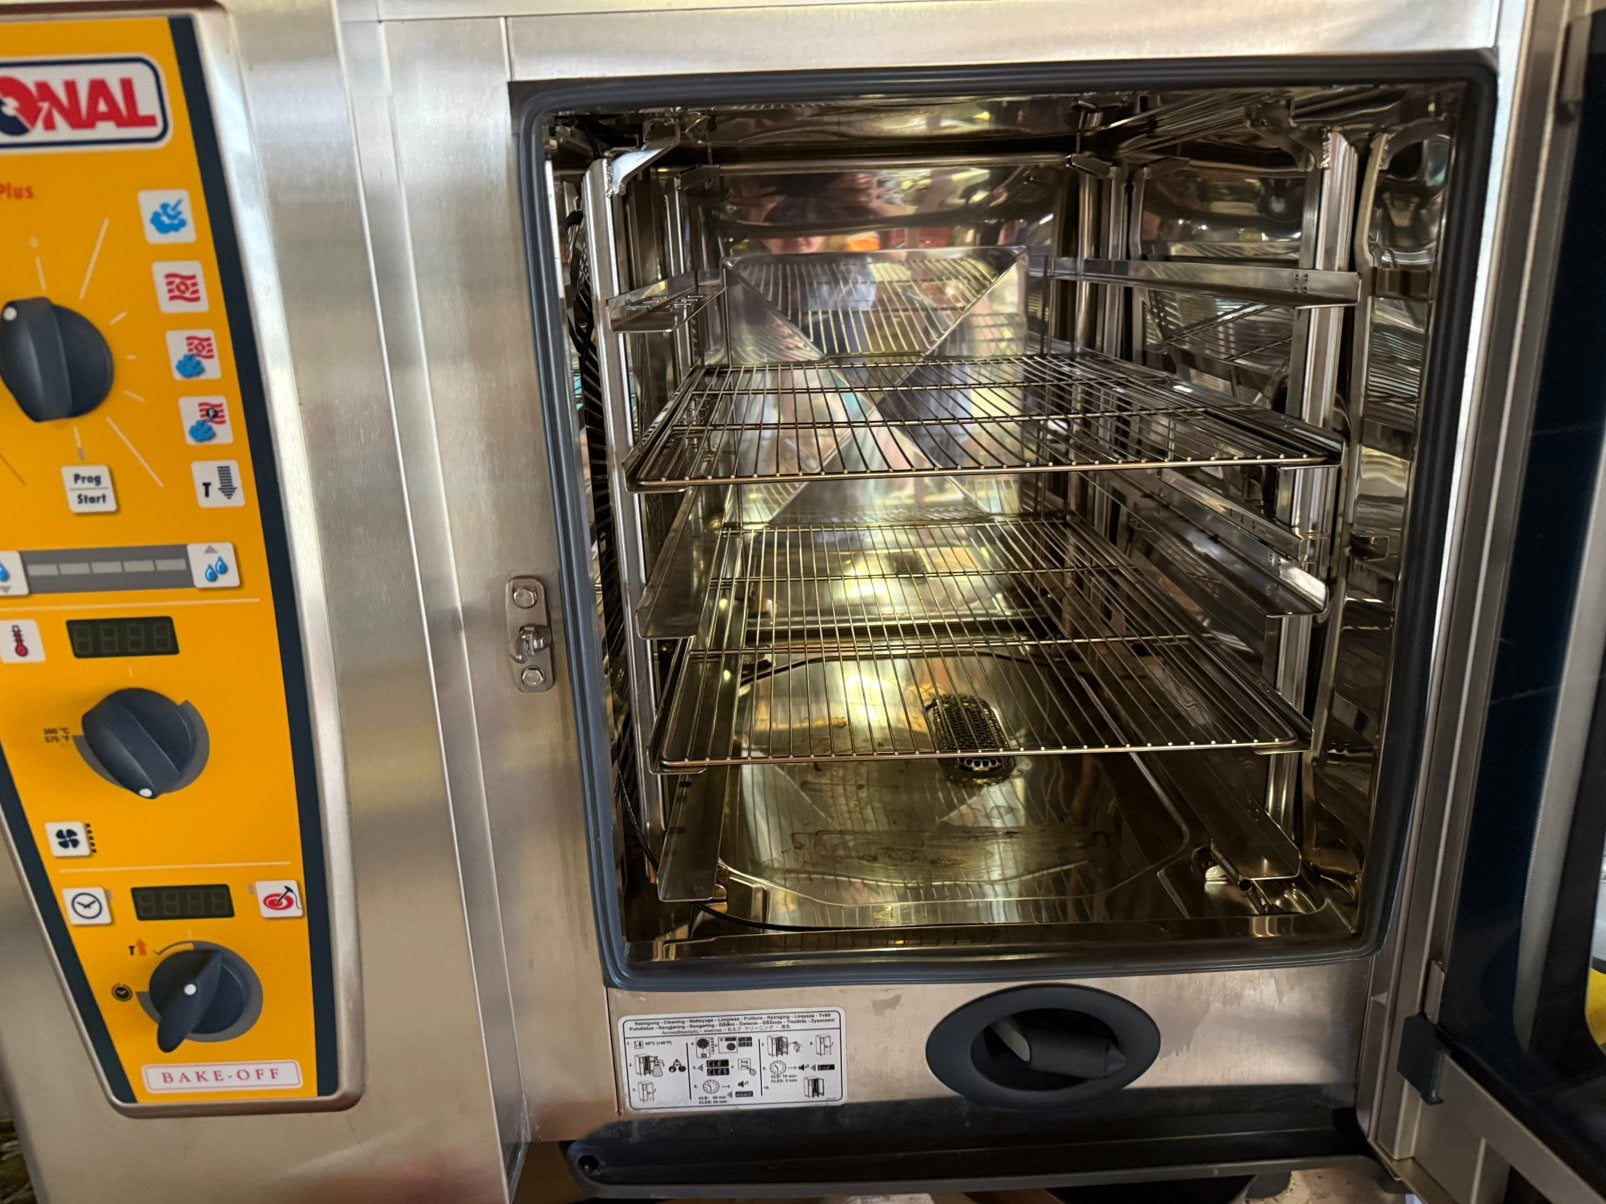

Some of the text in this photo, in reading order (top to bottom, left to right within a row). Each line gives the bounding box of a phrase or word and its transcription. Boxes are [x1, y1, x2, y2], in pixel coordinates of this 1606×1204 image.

[74, 473, 101, 486] Prog
[202, 482, 211, 498] T
[77, 493, 106, 505] Start
[128, 945, 135, 956] T
[161, 1068, 279, 1083] BAKE-OFF
